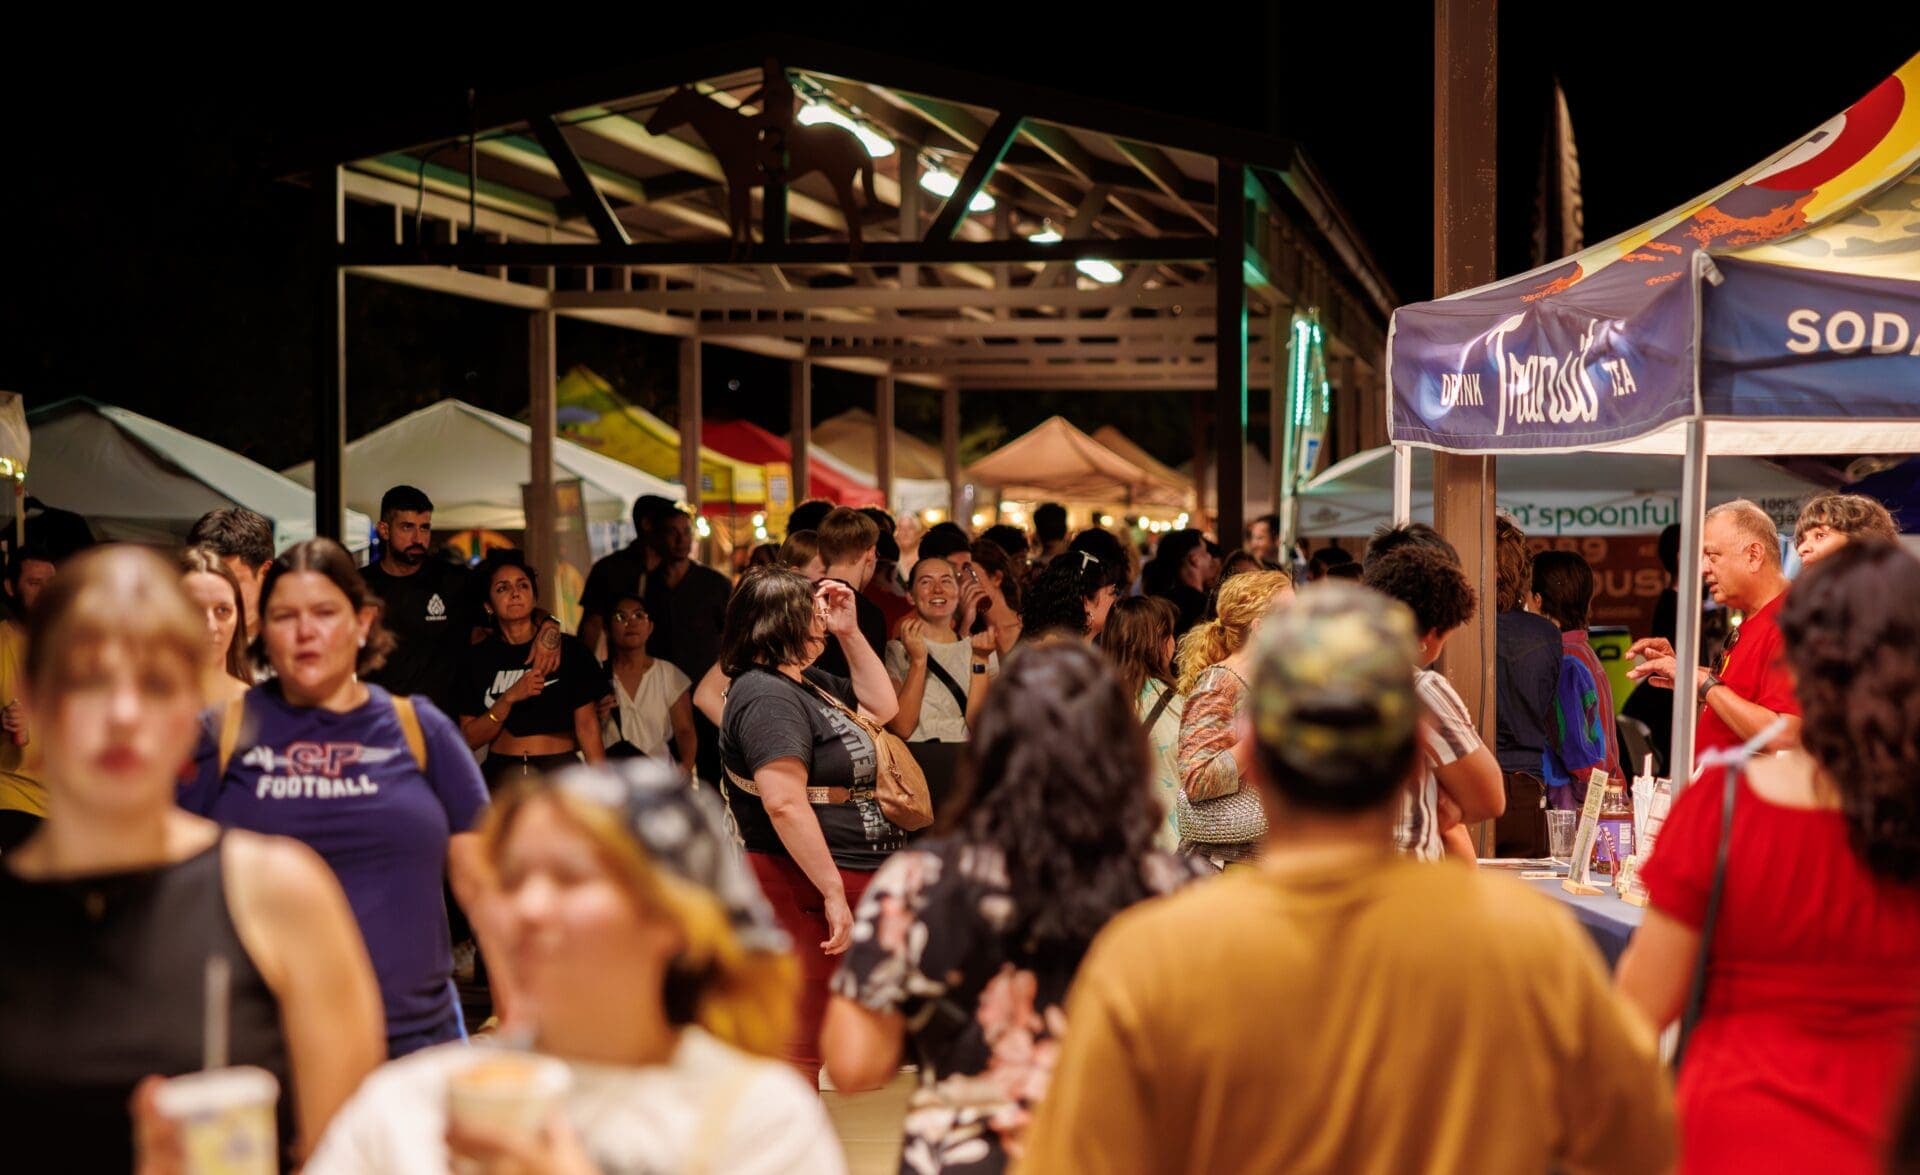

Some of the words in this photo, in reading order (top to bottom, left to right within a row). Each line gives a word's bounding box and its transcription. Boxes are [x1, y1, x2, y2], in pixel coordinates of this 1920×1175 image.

[1441, 373, 1484, 406] DRINK
[1601, 358, 1637, 397] TEA
[1539, 498, 1680, 535] spoonful
[256, 774, 379, 799] FOOTBALL
